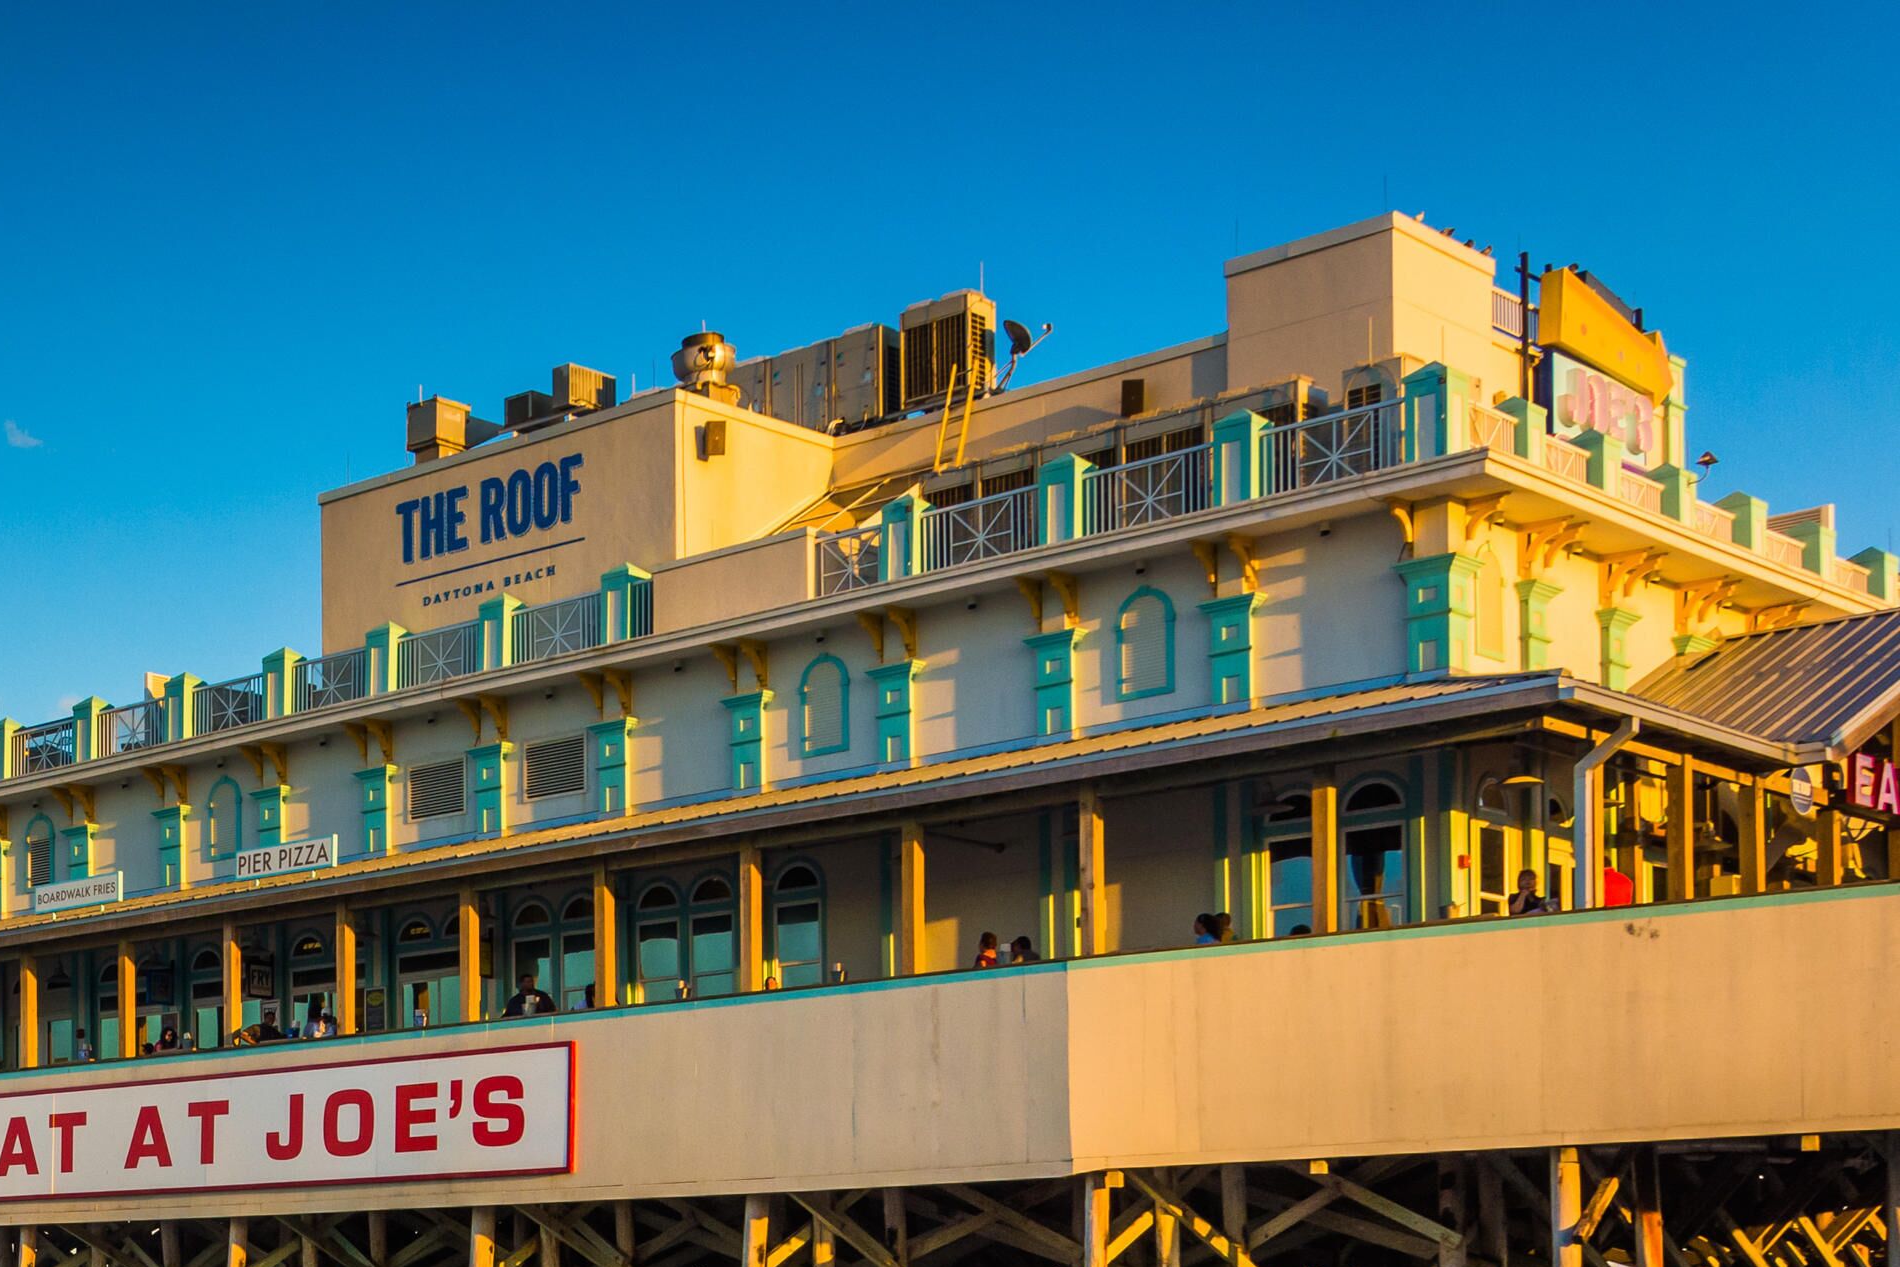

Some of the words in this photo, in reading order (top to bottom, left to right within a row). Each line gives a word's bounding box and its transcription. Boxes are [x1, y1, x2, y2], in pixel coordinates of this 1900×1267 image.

[396, 485, 469, 565] THE
[480, 453, 583, 544] ROOF
[422, 580, 495, 606] DAYTONA
[504, 565, 557, 588] BEACH
[238, 851, 273, 877] PIER
[278, 842, 329, 868] PIZZA
[37, 886, 91, 905] BOARDWALK
[93, 881, 116, 896] FRIES
[251, 968, 270, 986] FRY
[124, 1099, 230, 1170] AT
[265, 1074, 525, 1162] JOE'S
